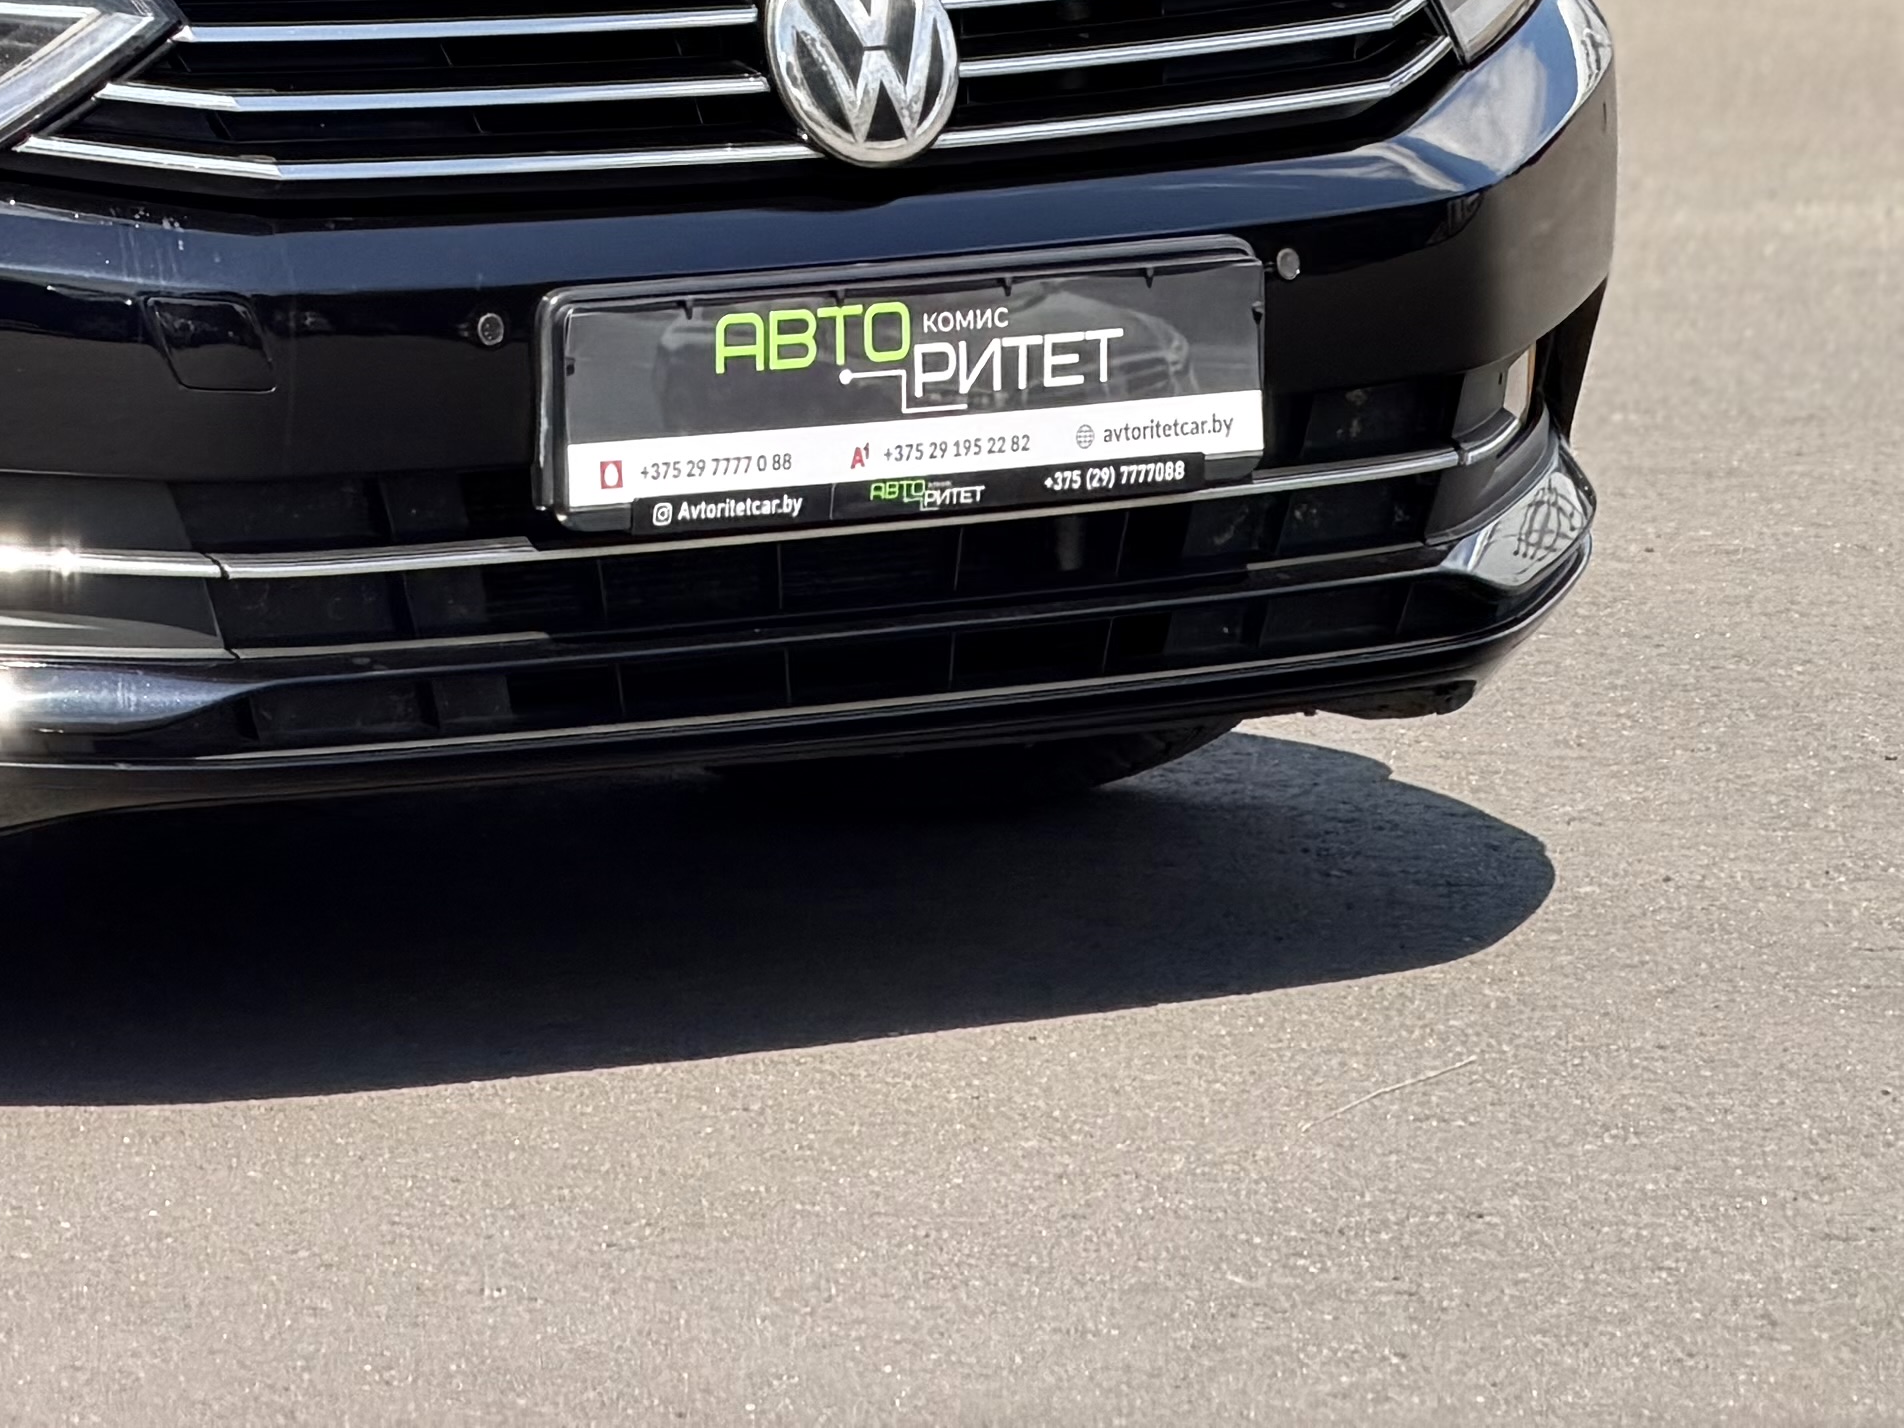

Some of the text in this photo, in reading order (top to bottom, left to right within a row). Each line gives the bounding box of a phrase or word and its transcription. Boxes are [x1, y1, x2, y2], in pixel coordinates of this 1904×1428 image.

[922, 306, 1009, 333] КОМИС
[715, 302, 911, 374] АВТО
[913, 328, 1124, 397] РИТЕТ
[1103, 413, 1234, 443] avtoritetcar.by
[883, 443, 924, 462] +375
[928, 441, 948, 459] 29
[953, 438, 982, 457] 195
[987, 436, 1006, 454] 22
[1010, 434, 1030, 452] 82
[640, 453, 792, 480] +375 29 7777 0 88
[1044, 460, 1185, 491] +375 (29) 7777088
[870, 479, 925, 501] АВТО
[924, 485, 986, 506] РИТЕТ
[677, 494, 803, 520] Avtoritetcar.by
